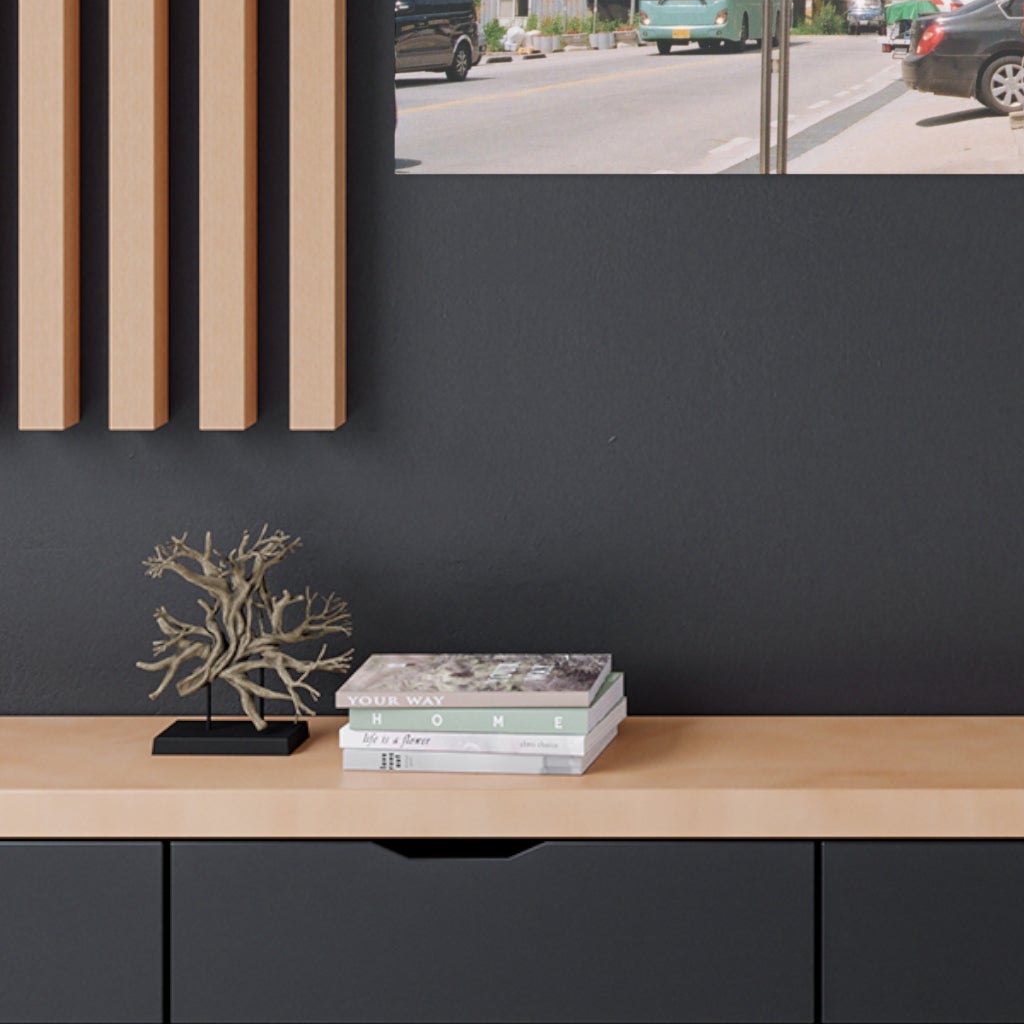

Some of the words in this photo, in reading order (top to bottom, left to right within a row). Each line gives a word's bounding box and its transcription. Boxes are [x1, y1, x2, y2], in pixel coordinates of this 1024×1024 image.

[347, 695, 399, 706] YOUR
[406, 695, 445, 706] WAY
[362, 732, 380, 745] life
[399, 734, 431, 748] flower
